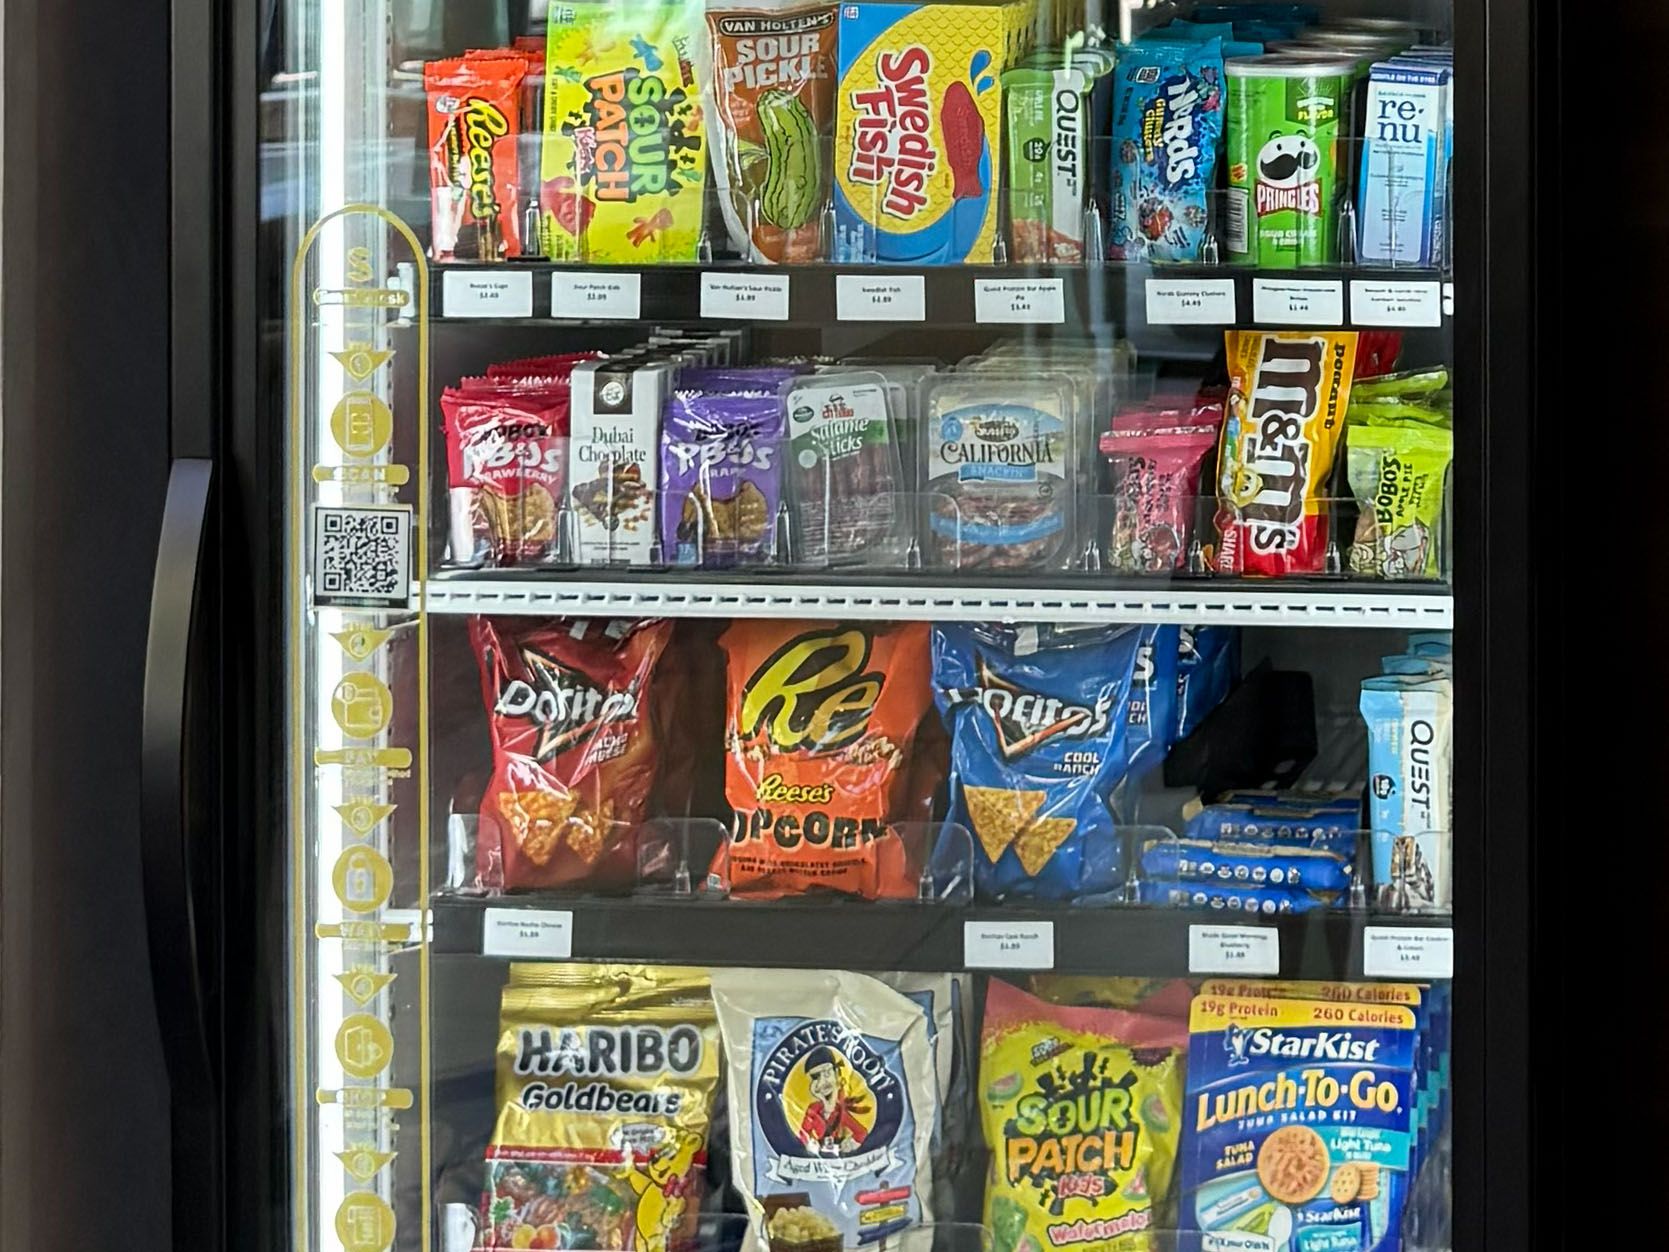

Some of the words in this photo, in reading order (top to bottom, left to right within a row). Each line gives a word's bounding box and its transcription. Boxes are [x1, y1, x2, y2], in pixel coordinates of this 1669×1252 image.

[725, 20, 756, 33] VAN
[736, 32, 820, 64] SOUR
[725, 54, 828, 92] PICKLE
[590, 73, 629, 201] PATCH
[627, 75, 668, 195] SOUR
[852, 87, 895, 183] Fish
[880, 47, 936, 217] Swedish
[1056, 90, 1078, 178] QUEST
[1378, 120, 1423, 144] nu
[1257, 181, 1320, 214] PRINGLES
[592, 427, 634, 446] Dubai
[940, 440, 1055, 466] CALIFORNIA
[1377, 456, 1402, 524] BOBO'S
[1053, 763, 1101, 776] RANCH
[1064, 752, 1100, 764] COOL
[1411, 719, 1434, 810] QUEST
[759, 773, 833, 803] Reese's
[1356, 988, 1411, 1002] Calories
[1201, 1001, 1225, 1016] 19g
[1229, 1002, 1279, 1017] Protein
[1313, 1007, 1344, 1020] 260
[1348, 1008, 1404, 1025] Calories
[518, 1027, 701, 1073] HARIBO
[762, 1023, 843, 1089] PIRATE'S
[1249, 1028, 1380, 1062] StarKist
[522, 1082, 682, 1114] Goldbears
[1016, 1088, 1132, 1136] SOUR
[1238, 1116, 1274, 1130] TUNA
[1281, 1110, 1327, 1123] SALAD
[1332, 1110, 1357, 1122] KIT
[1007, 1130, 1134, 1182] PATCH
[1224, 1141, 1256, 1155] TUNA
